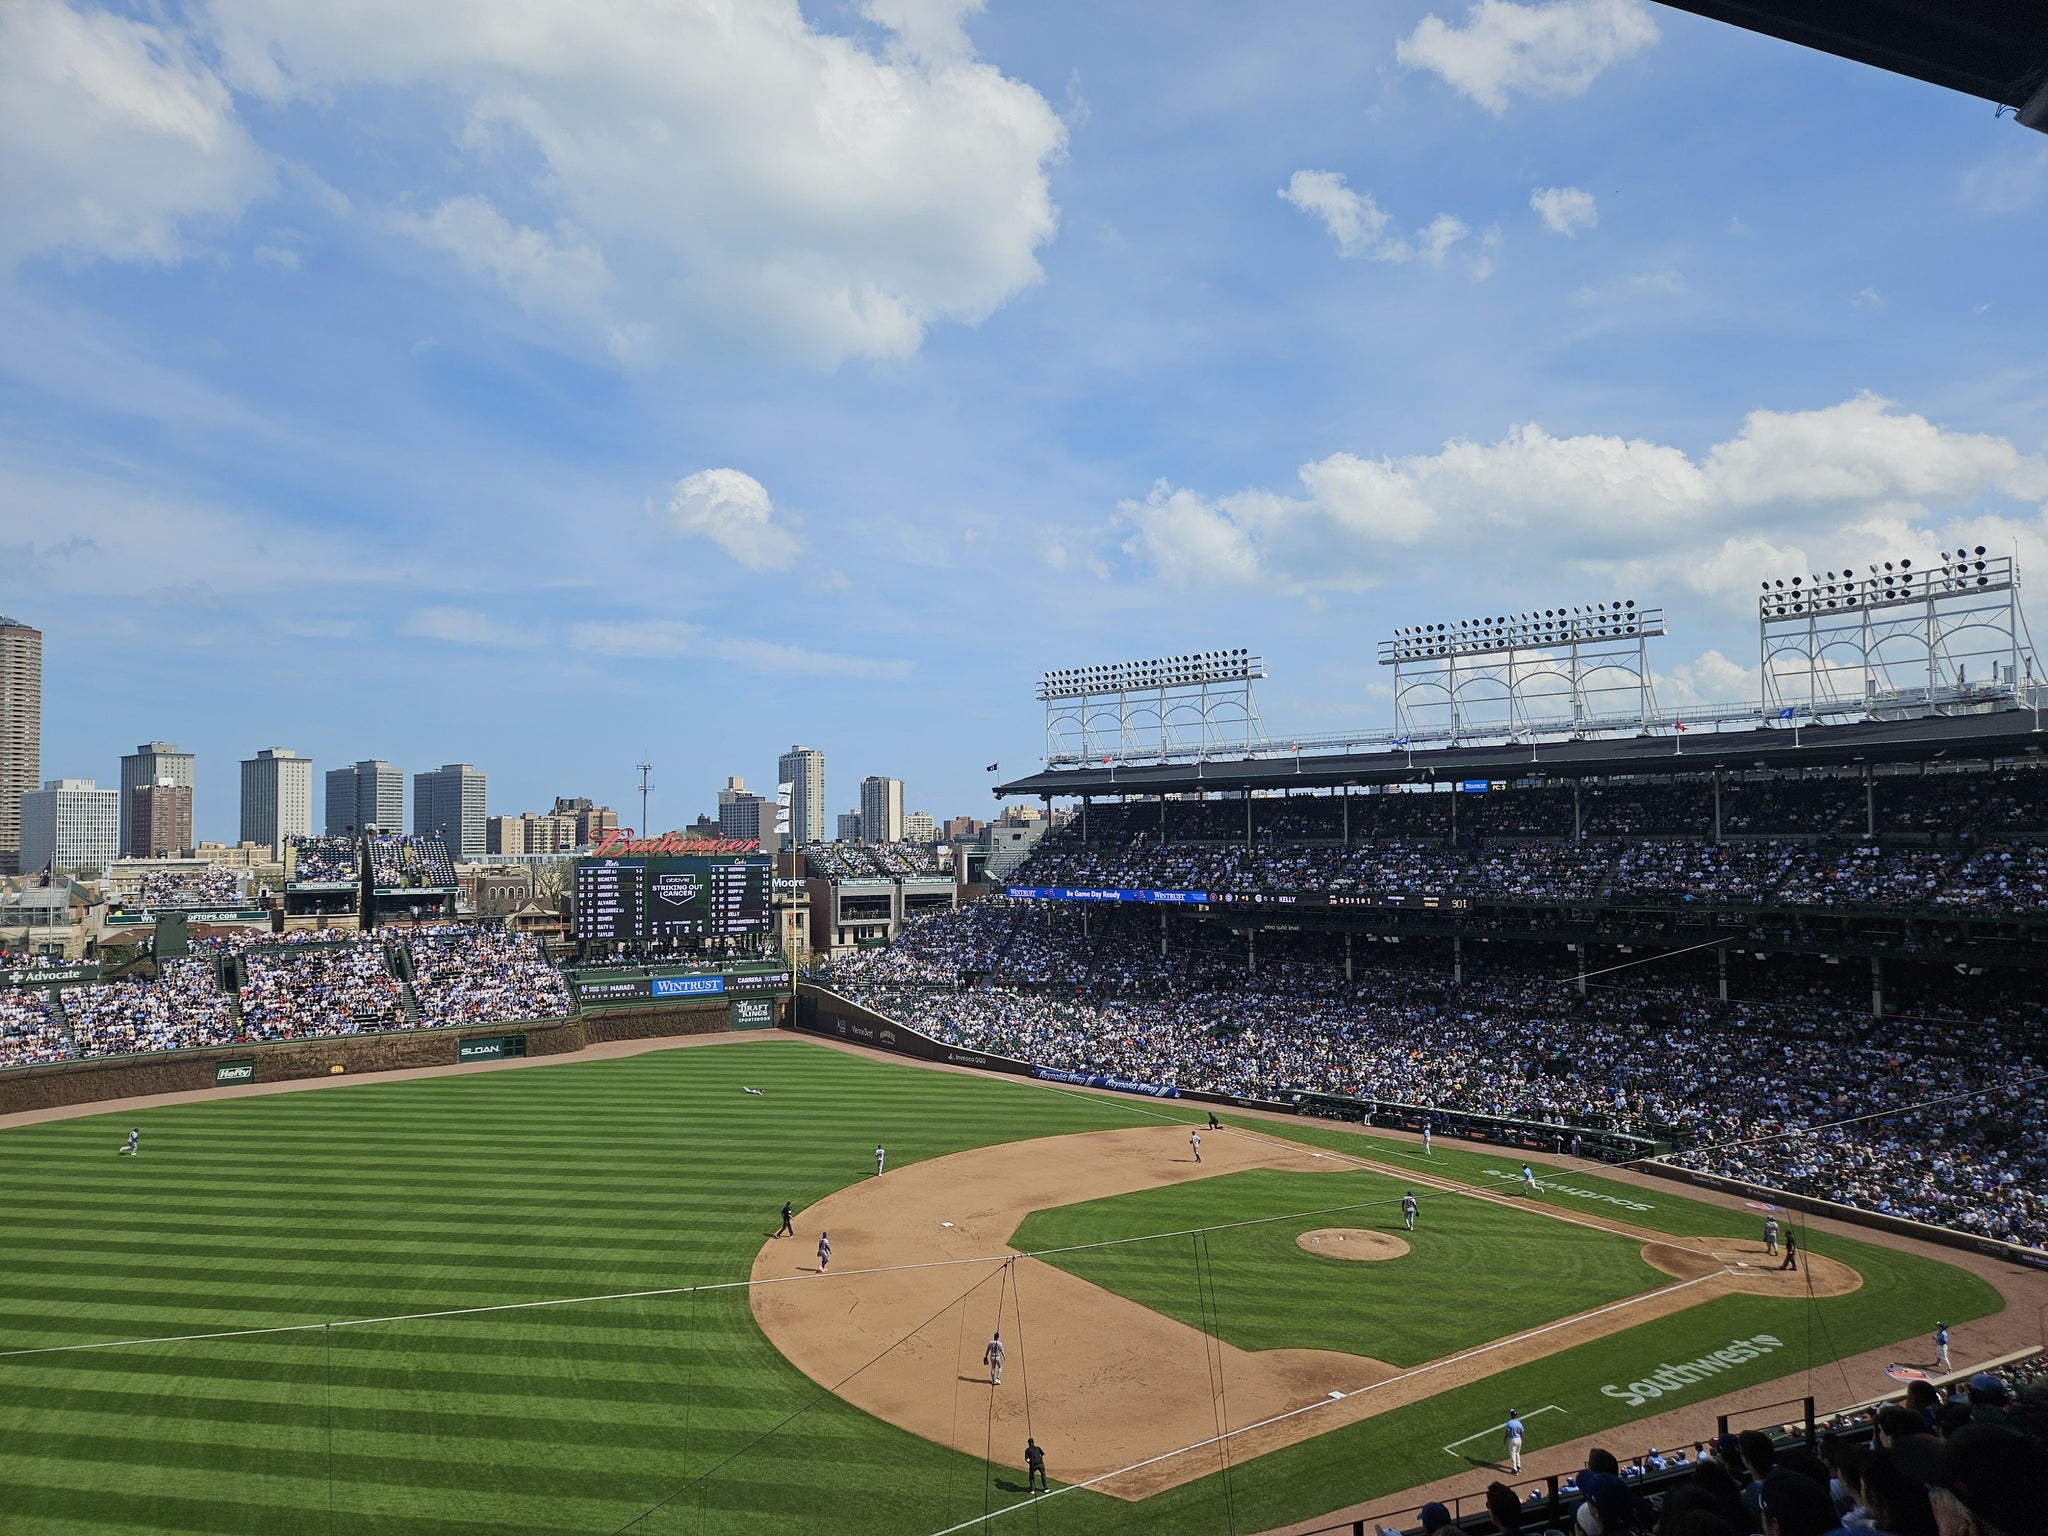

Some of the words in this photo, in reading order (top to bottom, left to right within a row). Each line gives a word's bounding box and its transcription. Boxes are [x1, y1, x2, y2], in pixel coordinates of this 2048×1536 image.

[589, 828, 761, 856] Budweiser
[772, 879, 805, 888] Moore
[1154, 892, 1186, 900] WINTRUST
[25, 970, 80, 982] Advocate
[658, 980, 719, 992] WINTRUST
[740, 1004, 768, 1013] DRAFT
[461, 1046, 499, 1055] SLOAN
[955, 1054, 975, 1063] Invesco
[220, 1067, 249, 1077] Hefty
[1039, 1070, 1067, 1082] Reynolds
[1068, 1073, 1085, 1086] Wrap
[1105, 1079, 1138, 1090] Reynolds
[1138, 1082, 1158, 1095] Wrap
[1600, 1339, 1772, 1406] Southwest
